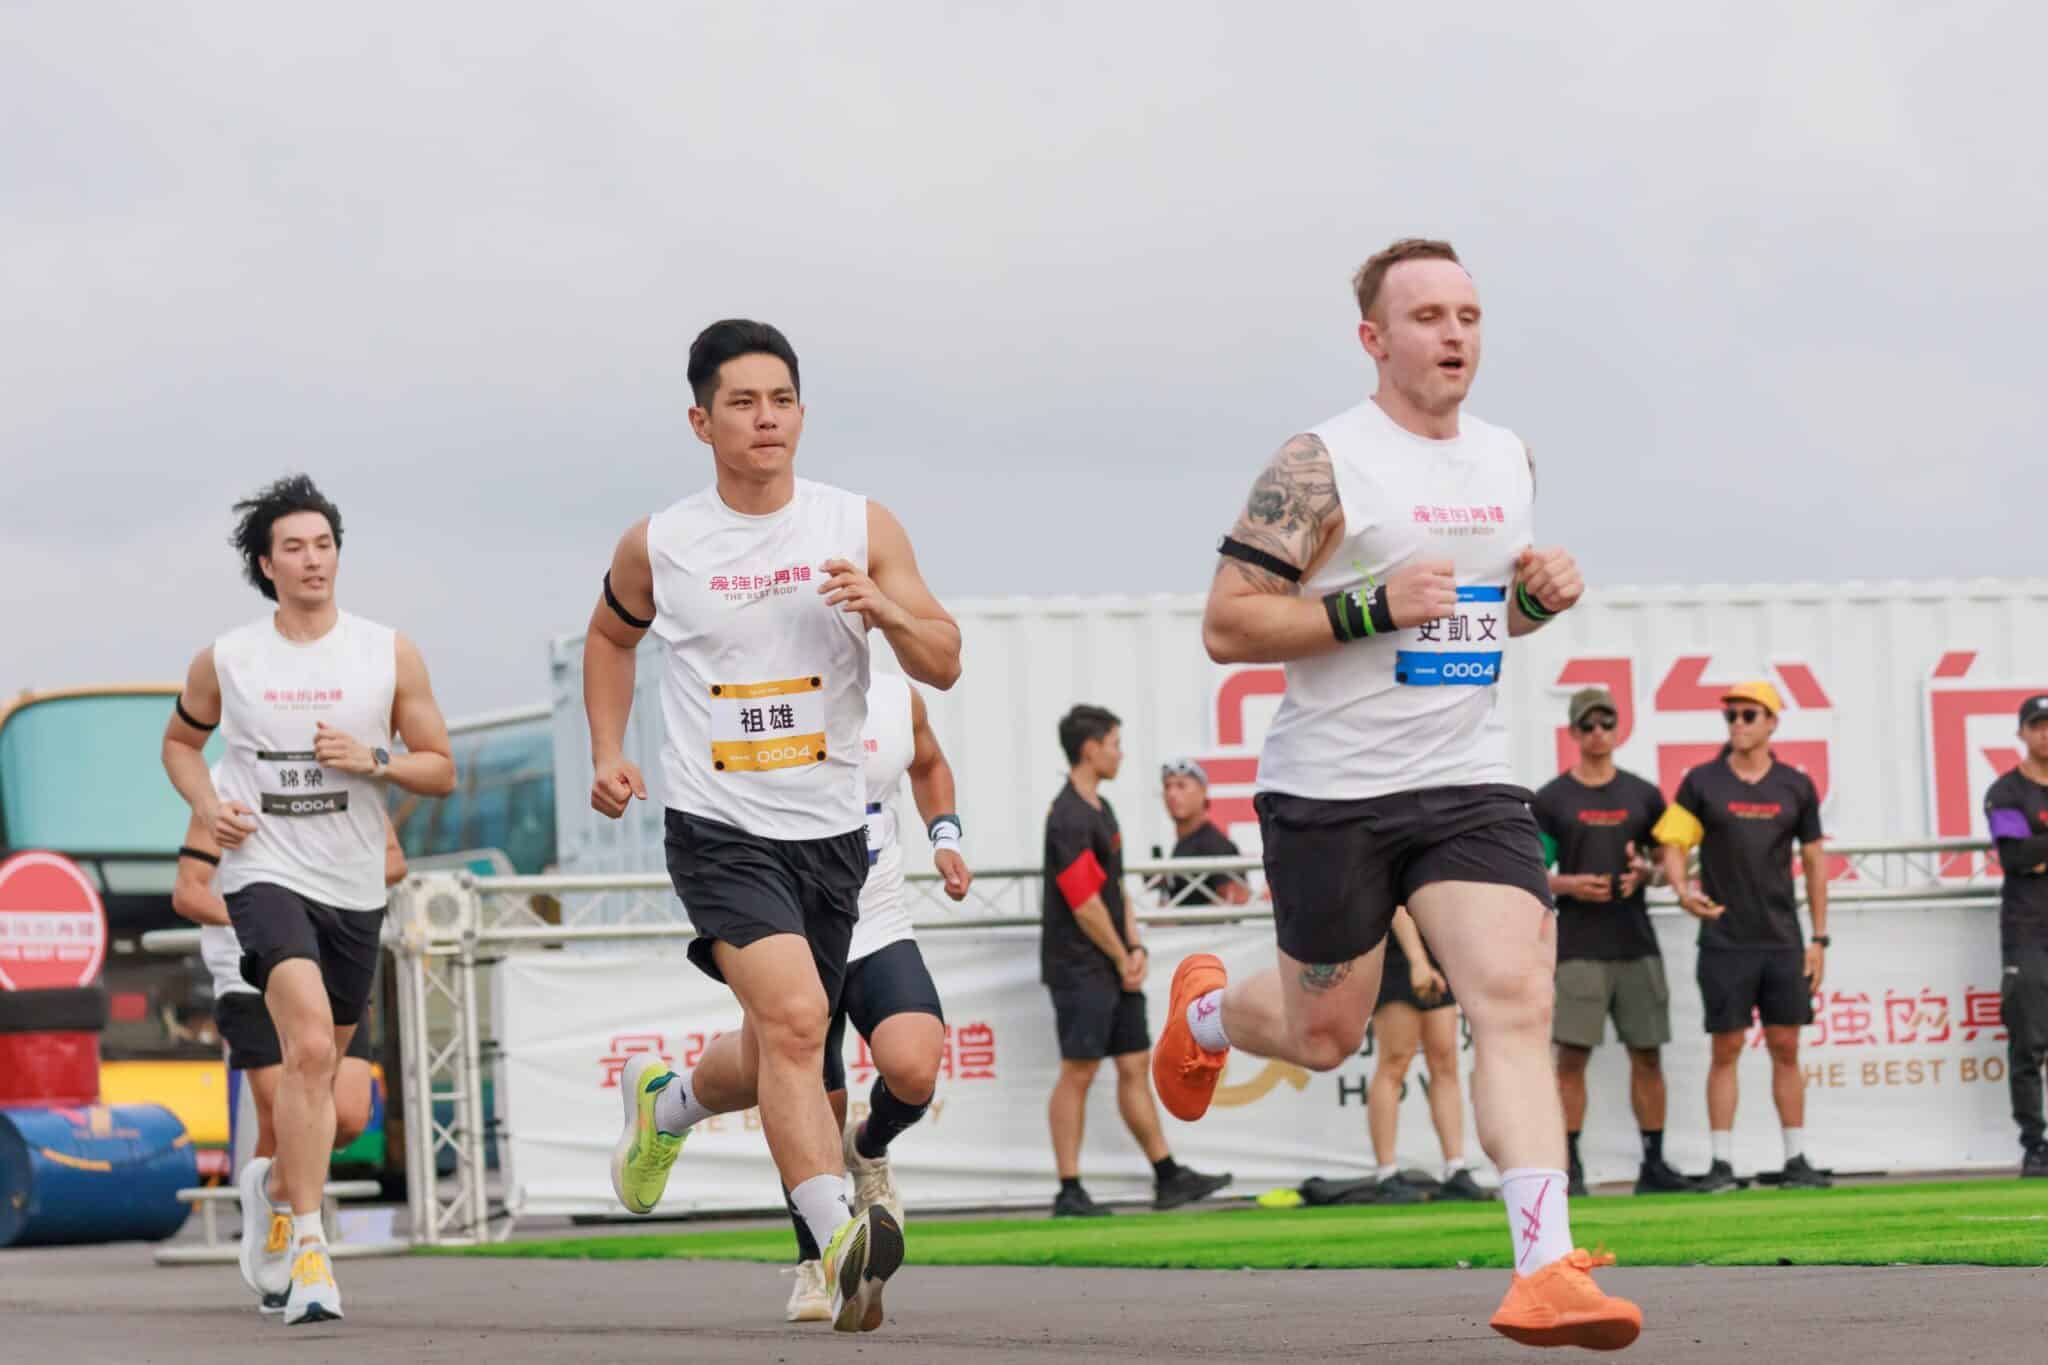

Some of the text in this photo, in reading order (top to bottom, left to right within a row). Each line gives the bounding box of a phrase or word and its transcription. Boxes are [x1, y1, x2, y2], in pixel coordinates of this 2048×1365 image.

[1442, 663, 1495, 678] 0004
[740, 704, 795, 733] 祖雄
[757, 745, 810, 763] 0004
[290, 799, 335, 813] 0004
[1803, 1055, 2006, 1088] HE BEST BO
